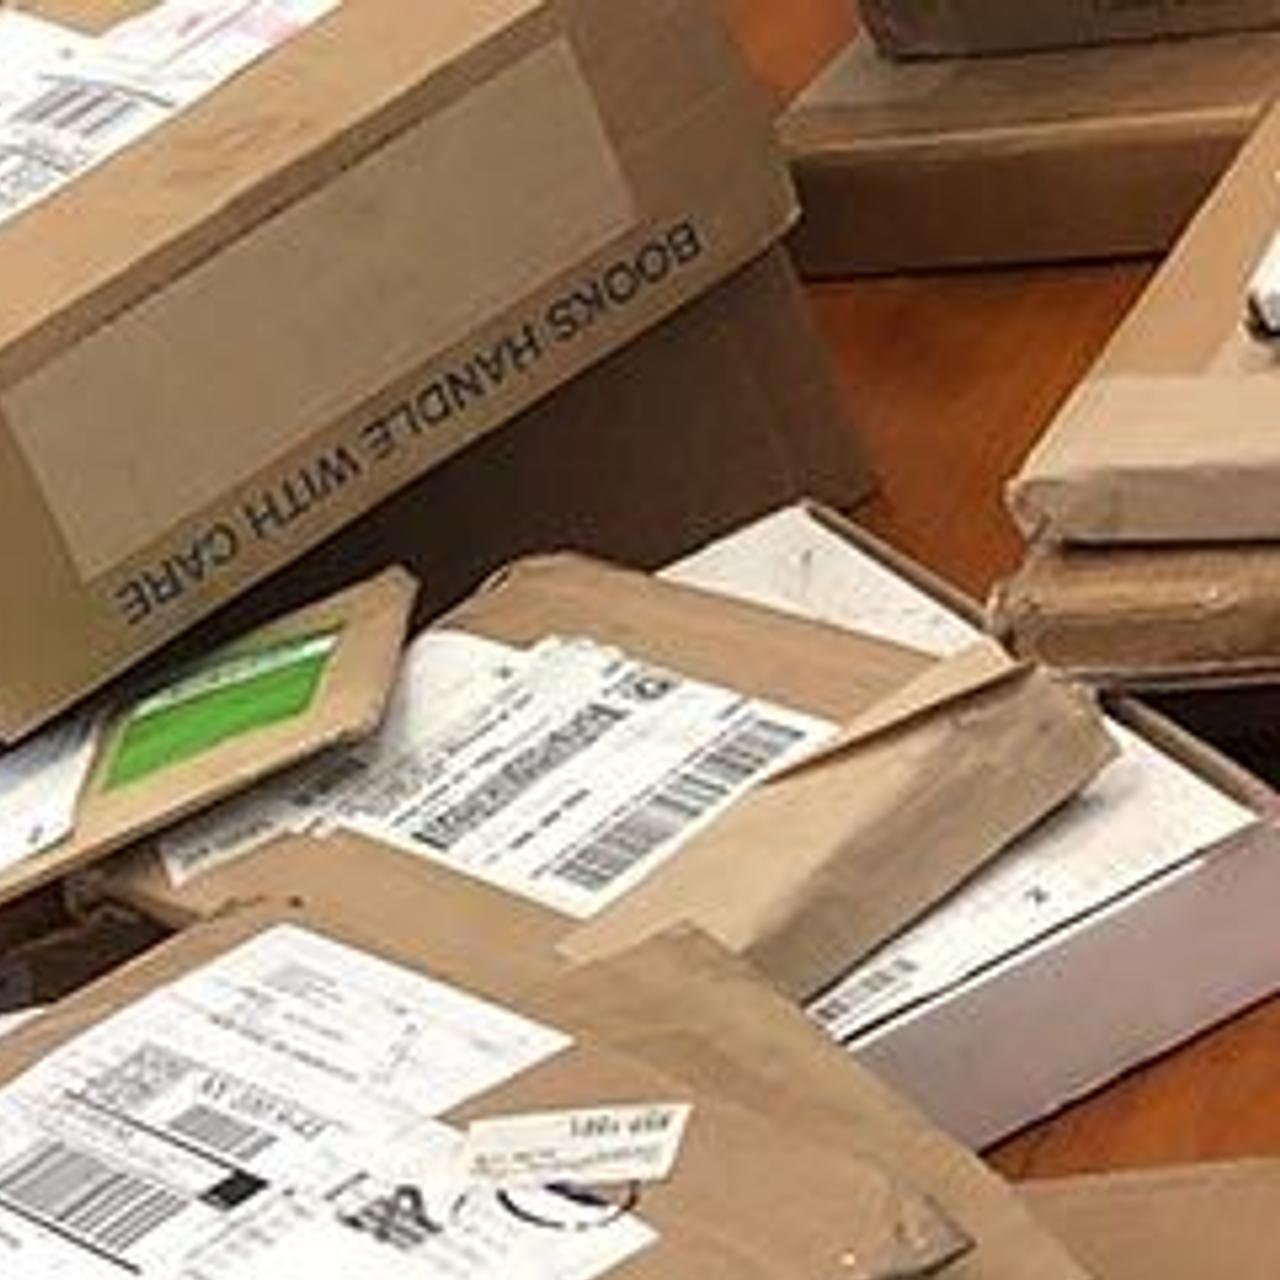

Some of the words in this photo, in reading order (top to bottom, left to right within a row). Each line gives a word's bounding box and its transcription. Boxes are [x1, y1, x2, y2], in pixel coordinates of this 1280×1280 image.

[550, 220, 702, 335] BOOKS
[357, 320, 546, 458] HANDLE
[246, 446, 365, 543] WITH
[118, 513, 239, 624] CARE
